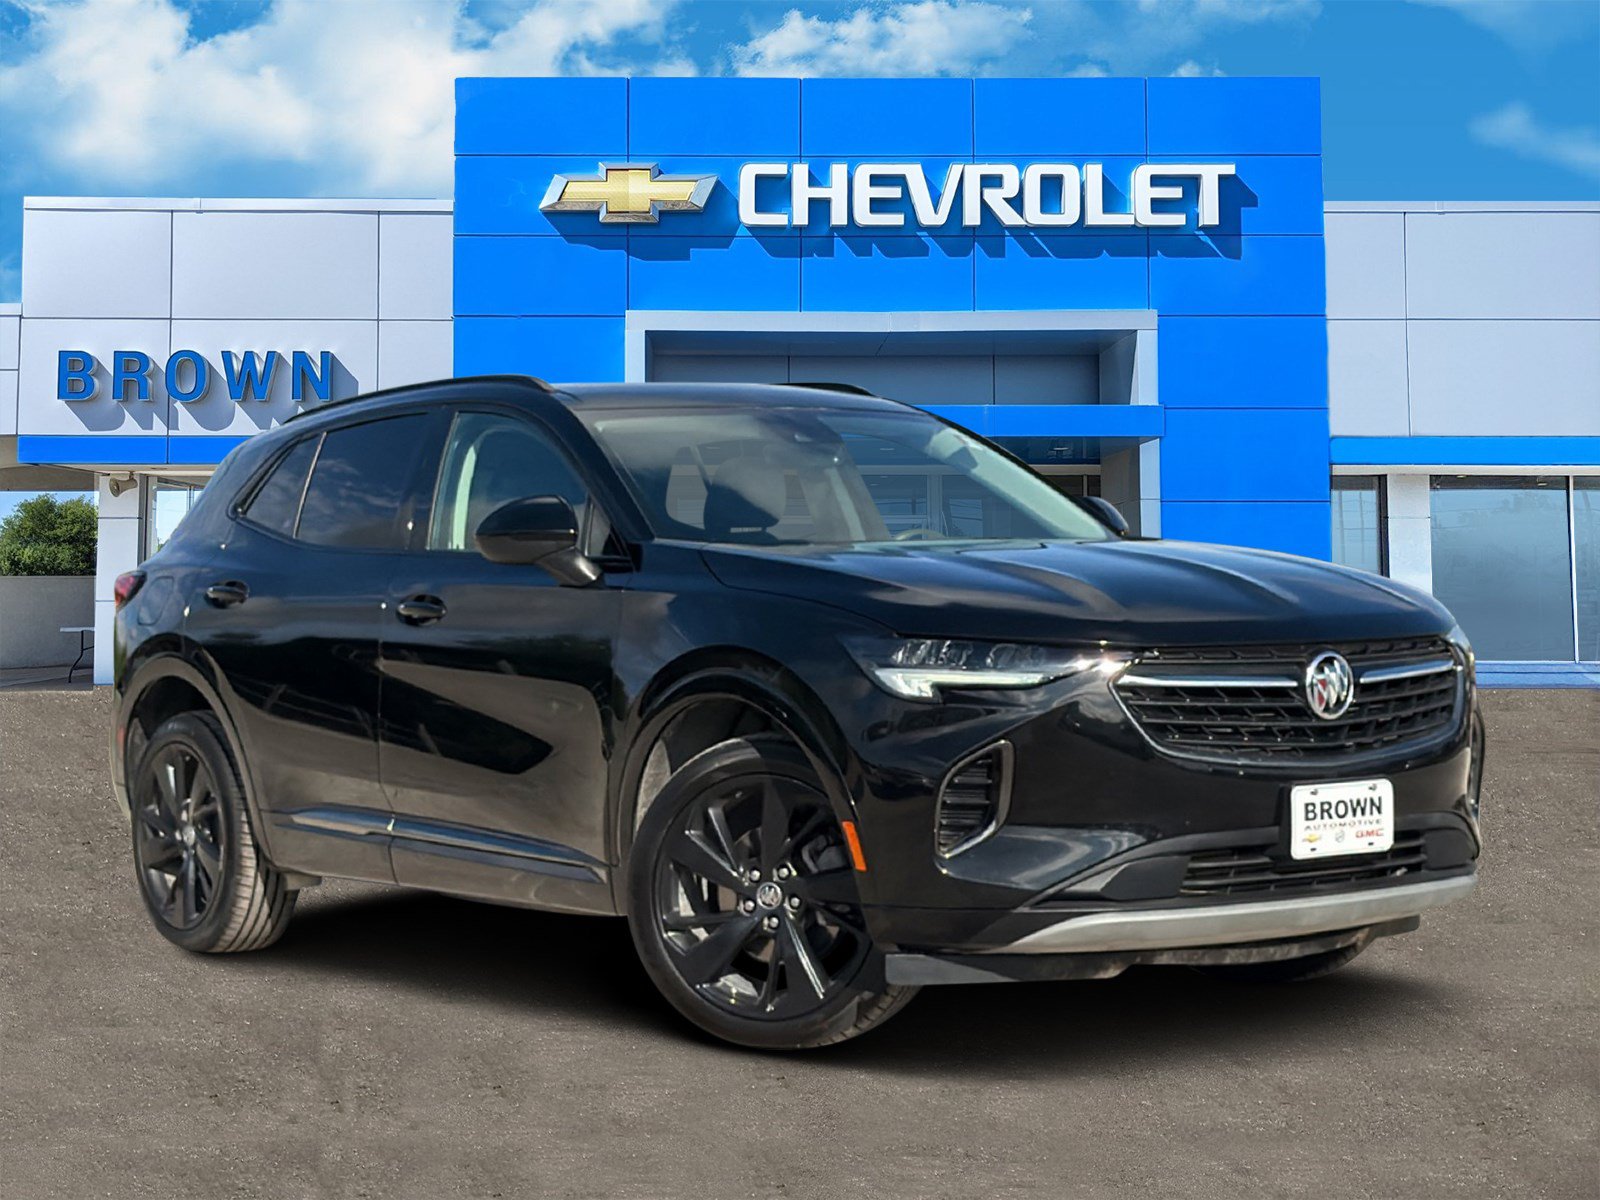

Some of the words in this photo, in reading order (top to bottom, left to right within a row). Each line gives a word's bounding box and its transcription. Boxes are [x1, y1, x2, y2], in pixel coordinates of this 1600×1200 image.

[738, 162, 1236, 227] CHEVROLET
[57, 349, 333, 402] BROWN
[1304, 796, 1382, 821] BROWN
[1304, 819, 1382, 831] AUTOMOTIVE
[1355, 828, 1384, 838] GMC
